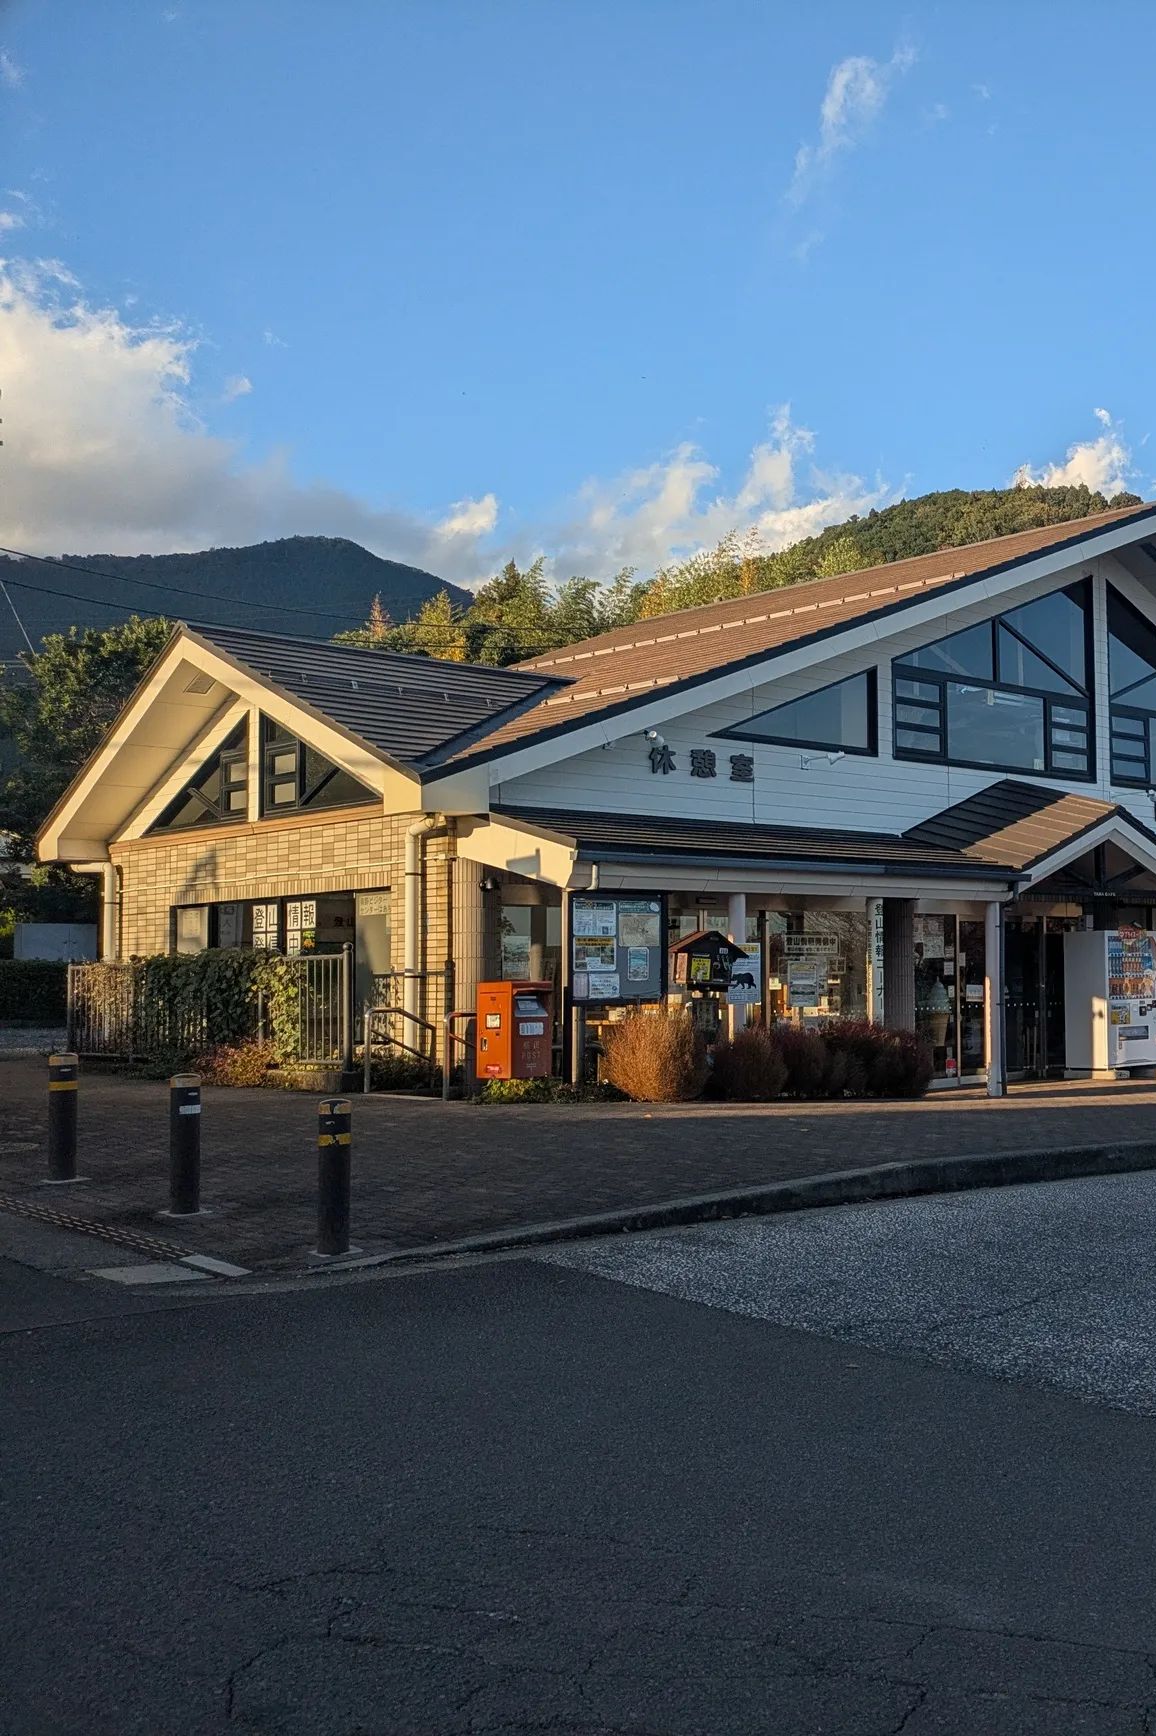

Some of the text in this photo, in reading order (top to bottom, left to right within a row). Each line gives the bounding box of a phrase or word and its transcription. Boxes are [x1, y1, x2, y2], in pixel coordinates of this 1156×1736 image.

[649, 745, 755, 782] 休憩室
[521, 1051, 541, 1059] POST
